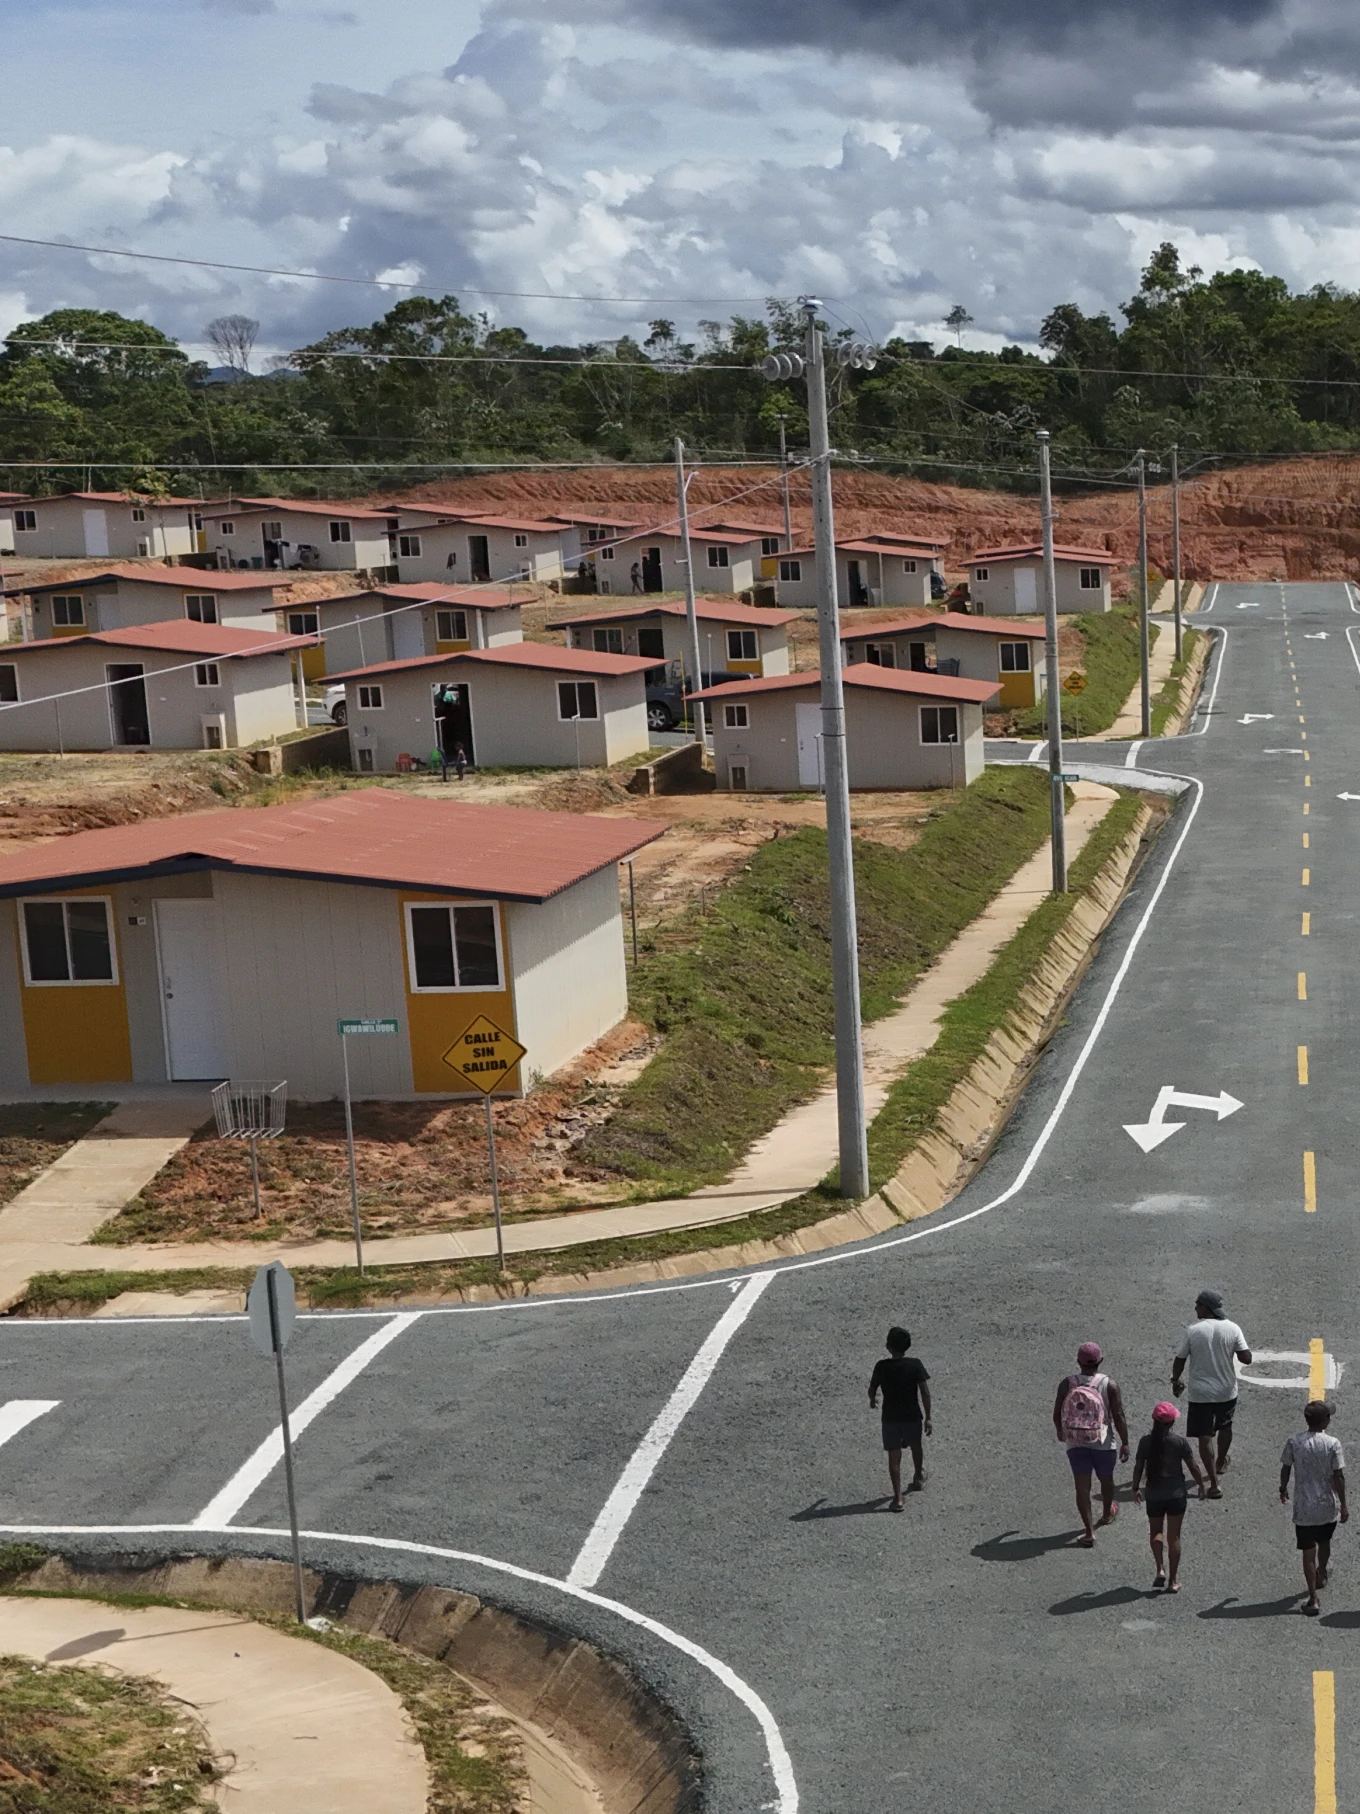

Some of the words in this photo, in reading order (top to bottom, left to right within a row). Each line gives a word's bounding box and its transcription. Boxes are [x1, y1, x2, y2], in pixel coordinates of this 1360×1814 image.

[464, 1031, 501, 1045] CALLE
[472, 1046, 495, 1058] SIN
[462, 1059, 508, 1074] SALIDA
